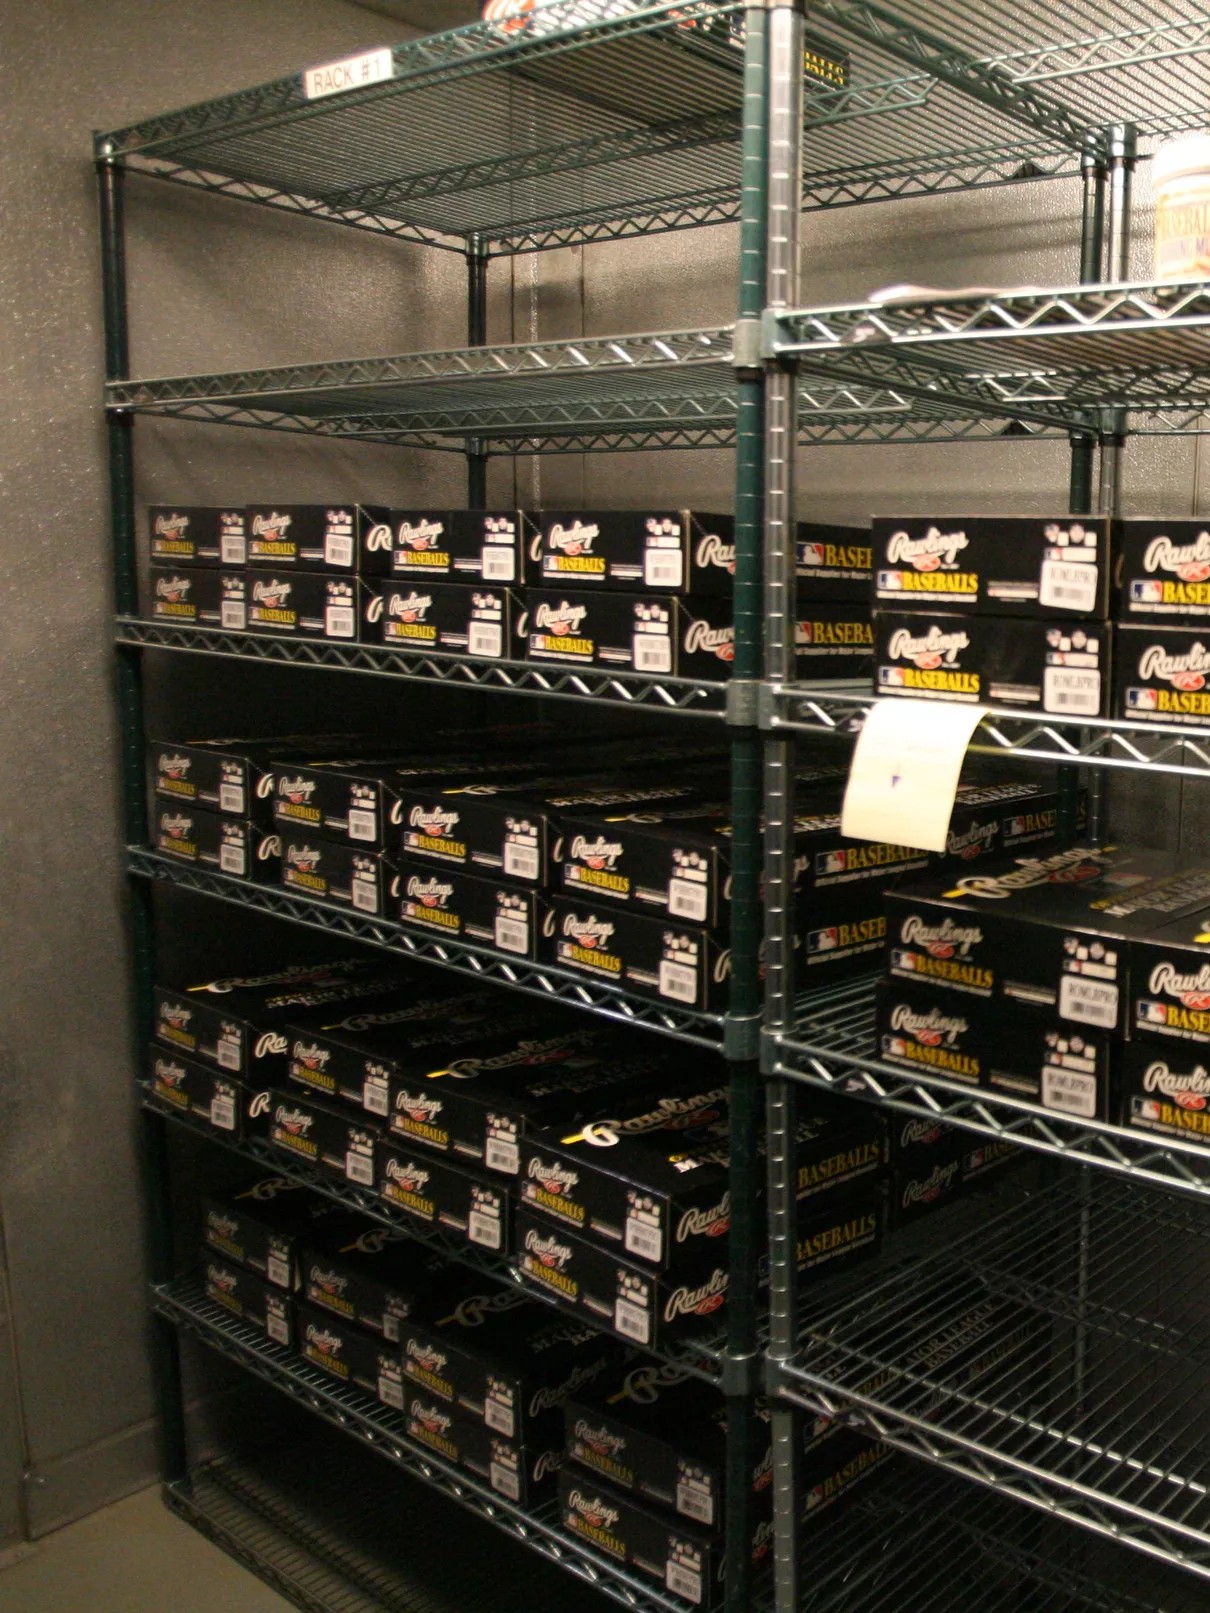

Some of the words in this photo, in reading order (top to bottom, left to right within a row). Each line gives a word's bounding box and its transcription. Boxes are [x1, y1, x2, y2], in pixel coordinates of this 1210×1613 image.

[313, 65, 354, 94] RACK
[399, 518, 444, 548] Rawlings
[550, 520, 599, 550] Rawlings
[887, 526, 969, 564] Rawlings
[259, 541, 297, 554] BASEBALLS
[406, 552, 450, 567] BASEBALLS
[558, 556, 606, 573] BASEBALLS
[903, 571, 979, 593] BASEBALLS
[260, 610, 297, 624] BASEBALLS
[389, 591, 432, 617] Rawlings
[537, 600, 587, 628] Rawlings
[396, 623, 437, 640] BASEBALLS
[545, 635, 595, 656] BASEBALLS
[889, 625, 970, 662] Rawlings
[905, 669, 981, 694] BASEBALLS
[279, 776, 317, 802] Rawlings
[285, 803, 322, 822] BASEBALLS
[409, 805, 460, 832] Rawlings
[417, 834, 467, 857] BASEBALLS
[571, 835, 624, 866] Rawlings
[407, 875, 454, 904] Rawlings
[580, 867, 631, 893] BASEBALLS
[415, 905, 461, 929] BASEBALLS
[563, 912, 615, 945] Rawlings
[901, 915, 984, 955] Rawlings
[572, 944, 623, 971] BASEBALLS
[916, 955, 994, 989] BASEBALLS
[890, 1004, 970, 1046] Rawlings
[906, 1042, 980, 1078] BASEBALLS
[396, 1091, 443, 1121] Rawlings
[403, 1120, 449, 1145] BASEBALLS
[385, 1158, 430, 1190] Rawlings
[527, 1156, 580, 1193] Rawlings
[392, 1186, 435, 1214] BASEBALLS
[536, 1190, 586, 1223] BASEBALLS
[526, 1229, 573, 1267] Rawlings
[533, 1262, 579, 1297] BASEBALLS
[569, 1490, 620, 1525] Rawlings
